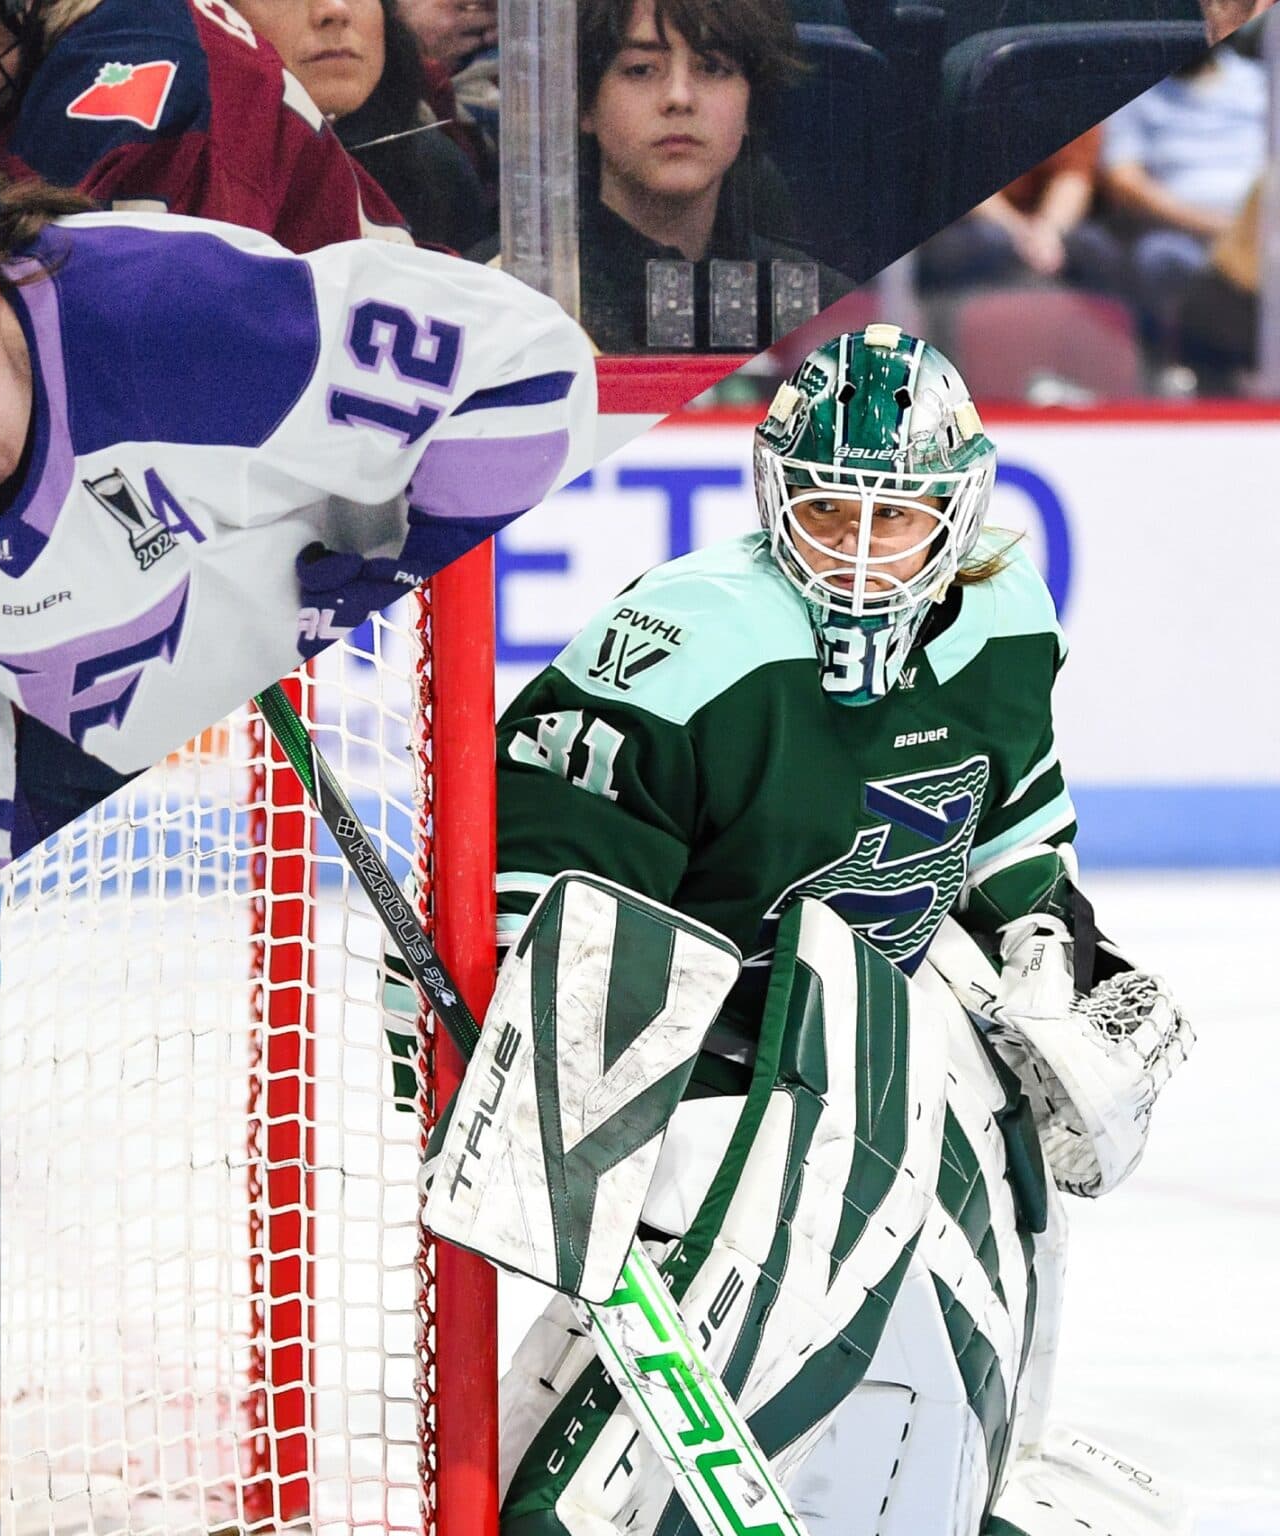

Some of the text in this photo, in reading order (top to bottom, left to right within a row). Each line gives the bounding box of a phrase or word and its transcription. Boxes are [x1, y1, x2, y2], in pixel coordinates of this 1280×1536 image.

[325, 297, 465, 449] 12
[144, 467, 207, 544] A
[137, 531, 179, 569] 202
[612, 607, 682, 646] PWHL
[821, 626, 894, 696] 31
[507, 709, 625, 801] 31
[348, 839, 432, 965] HZRDUS
[449, 1021, 522, 1203] TRUE
